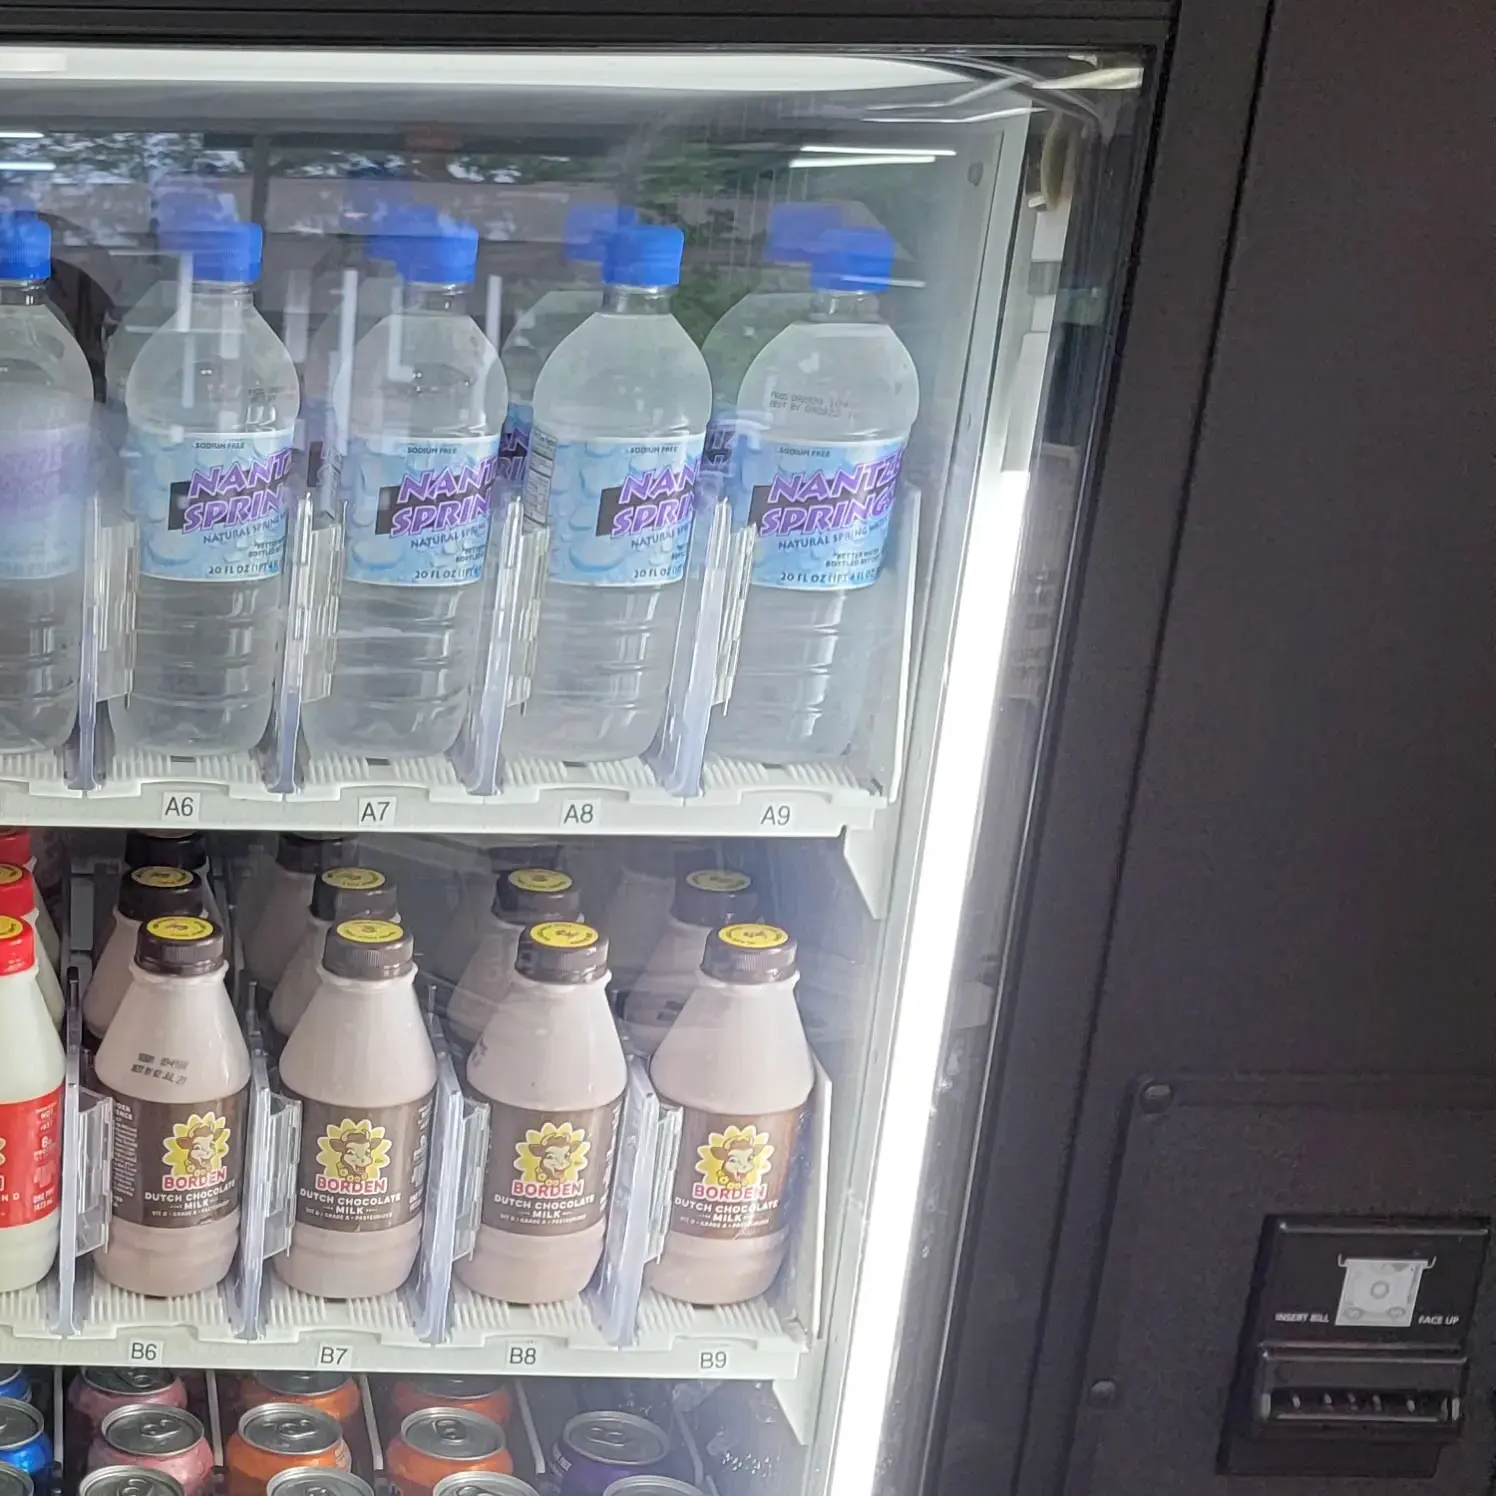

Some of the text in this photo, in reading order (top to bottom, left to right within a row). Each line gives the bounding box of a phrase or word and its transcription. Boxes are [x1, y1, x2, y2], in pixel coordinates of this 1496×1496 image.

[164, 797, 194, 817] A6
[360, 801, 390, 822] A7
[563, 803, 594, 824] A8
[761, 806, 791, 827] A9
[164, 1167, 227, 1190] BORDEN
[317, 1175, 386, 1194] BORDEN
[12, 1192, 20, 1200] D
[145, 1179, 236, 1203] DUTCH CHOCOLATE
[300, 1188, 401, 1206] DUTCH CHOCOLATE
[513, 1179, 583, 1198] BORDEN
[693, 1184, 766, 1201] BORDEN
[184, 1200, 209, 1211] MILK
[336, 1206, 364, 1215] MILK
[494, 1194, 595, 1210] DUTCH CHOCOLATE
[674, 1196, 778, 1214] DUTCH CHOCOLATE
[532, 1209, 561, 1219] MILK
[713, 1212, 742, 1222] MILK
[1275, 1312, 1308, 1323] INSERT
[1418, 1315, 1443, 1325] FACE
[1445, 1316, 1460, 1326] UP
[131, 1342, 157, 1361] B6
[320, 1347, 348, 1365] B7
[509, 1347, 536, 1365] B8
[700, 1352, 727, 1369] B9
